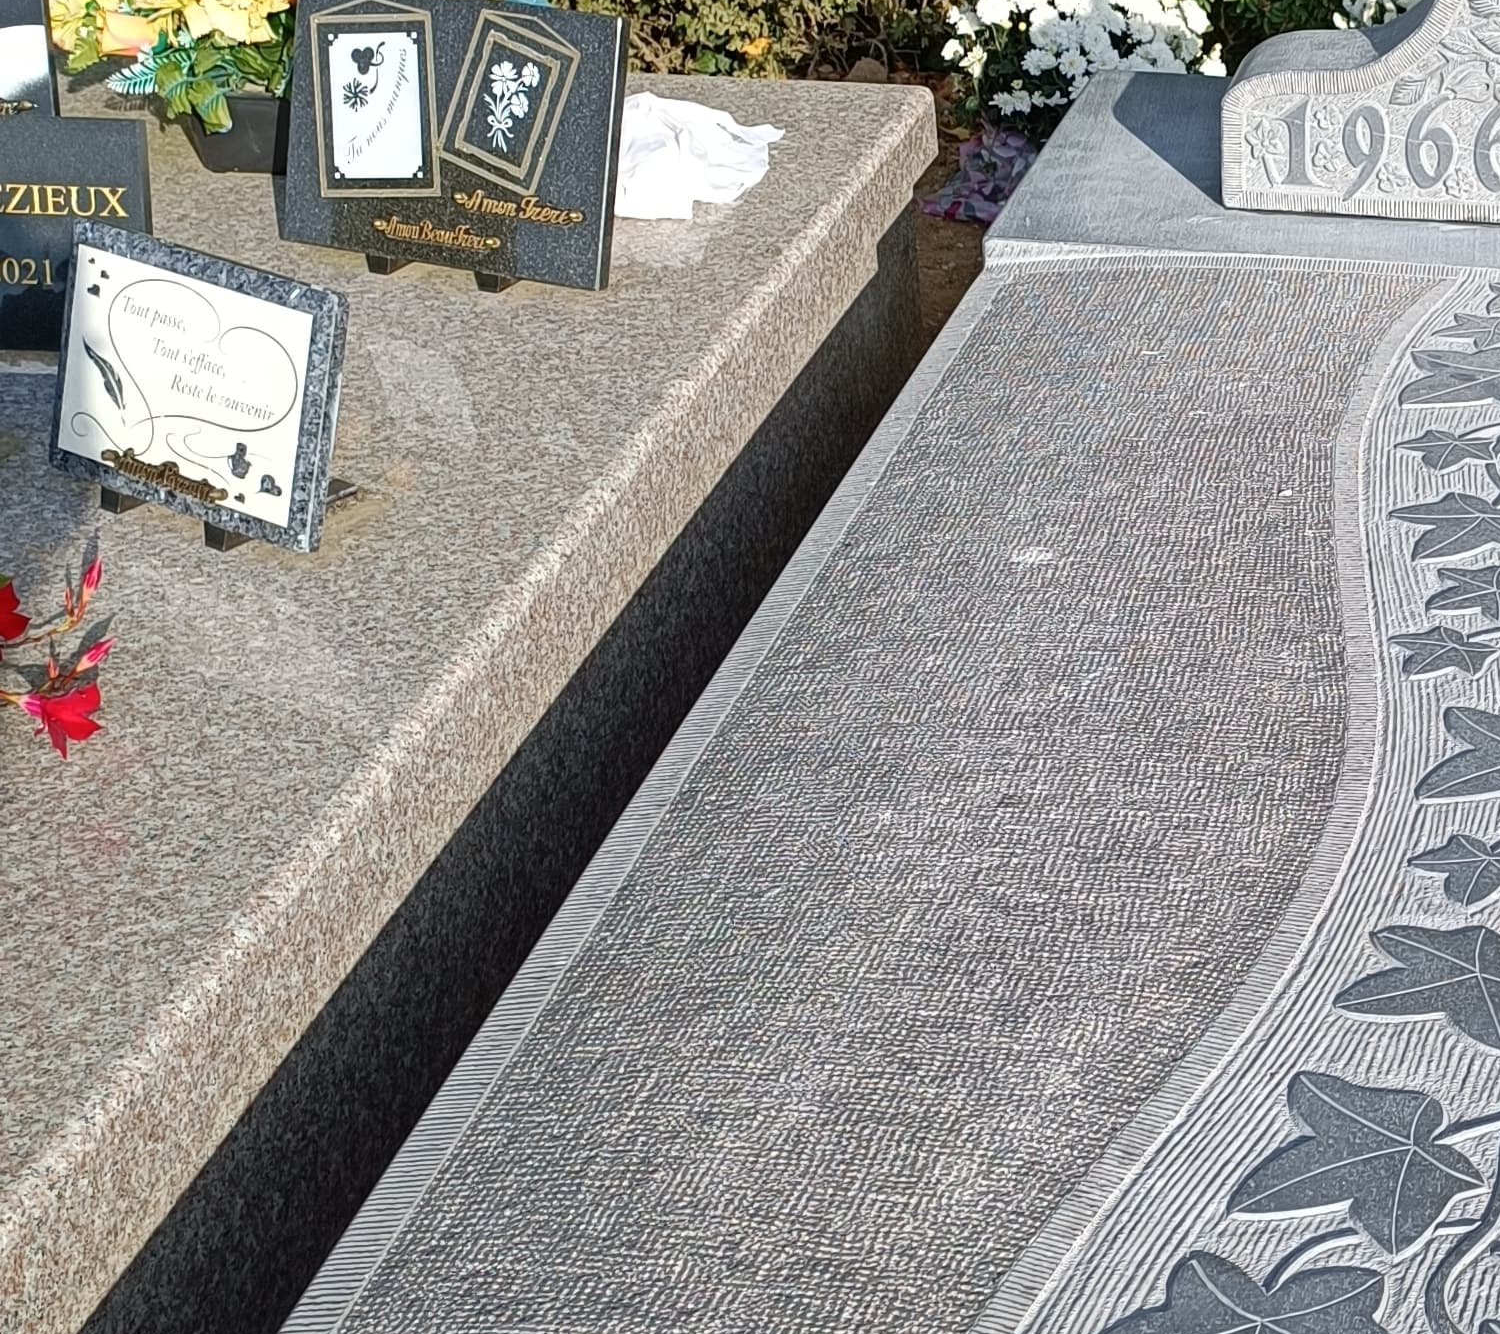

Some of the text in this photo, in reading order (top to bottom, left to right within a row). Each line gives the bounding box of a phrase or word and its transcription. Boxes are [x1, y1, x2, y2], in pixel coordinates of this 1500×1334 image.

[0, 183, 130, 218] ZIEUX
[0, 257, 54, 286] 021
[123, 295, 150, 318] Tout
[153, 337, 181, 361] Tout
[171, 374, 275, 421] Reste le souvenir
